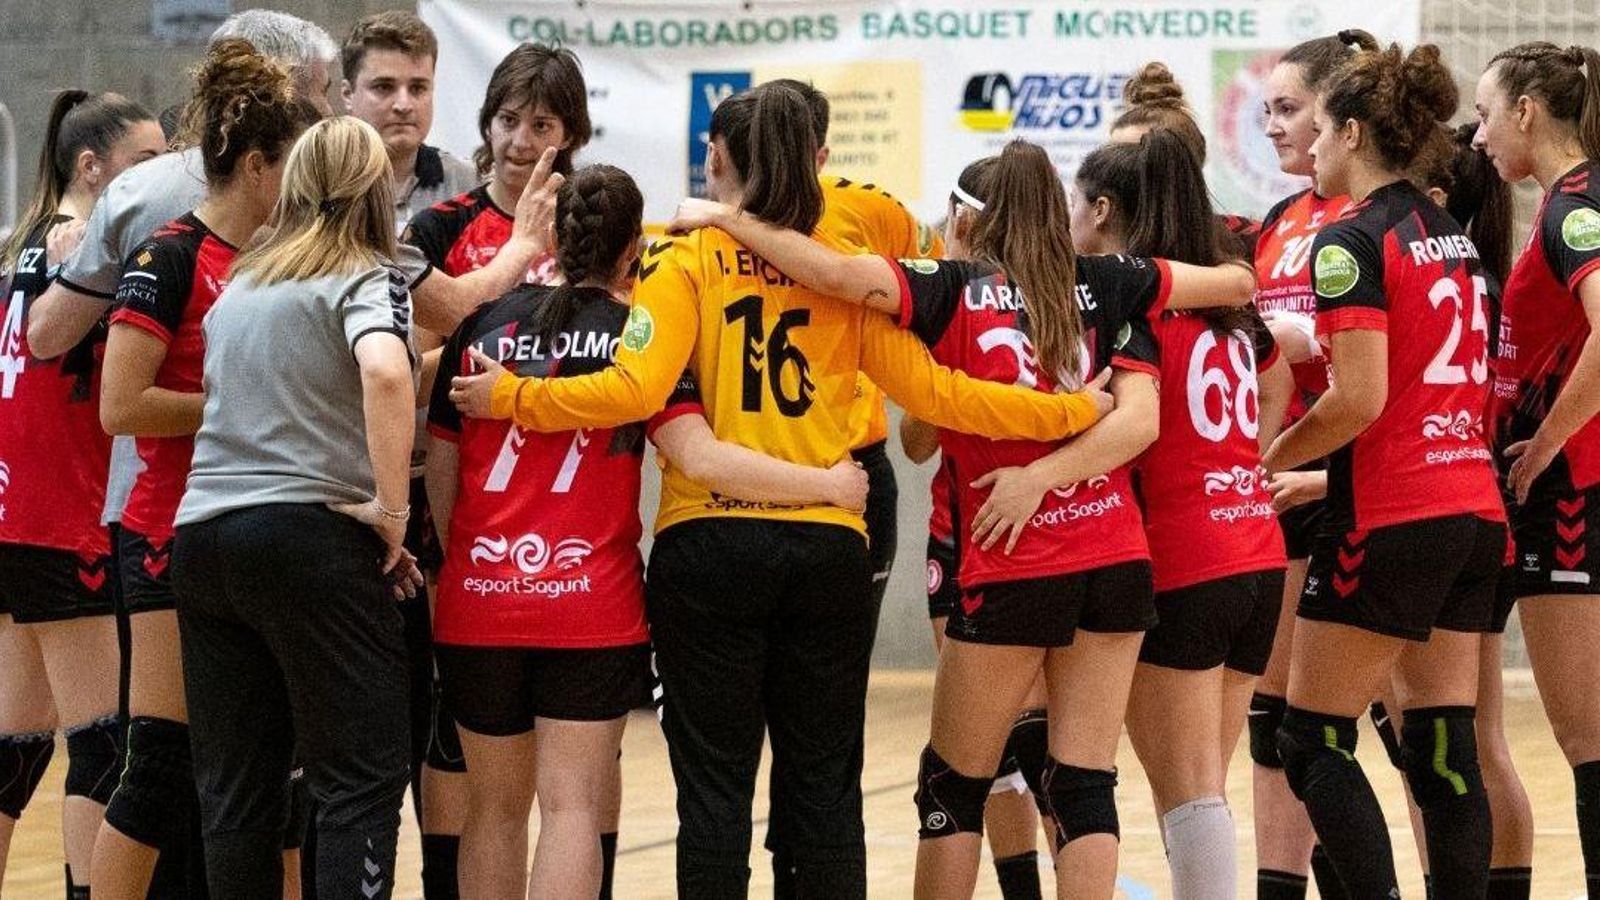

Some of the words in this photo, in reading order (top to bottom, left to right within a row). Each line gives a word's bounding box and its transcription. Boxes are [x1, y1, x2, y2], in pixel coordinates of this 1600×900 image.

[861, 11, 1031, 38] BASQUET
[1055, 9, 1258, 38] MORVEDRE
[1014, 74, 1127, 99] MIGUE
[1270, 232, 1317, 280] 10
[498, 334, 546, 362] DEL
[1422, 275, 1489, 385] 25
[724, 294, 817, 418] 16
[1186, 328, 1259, 443] 68
